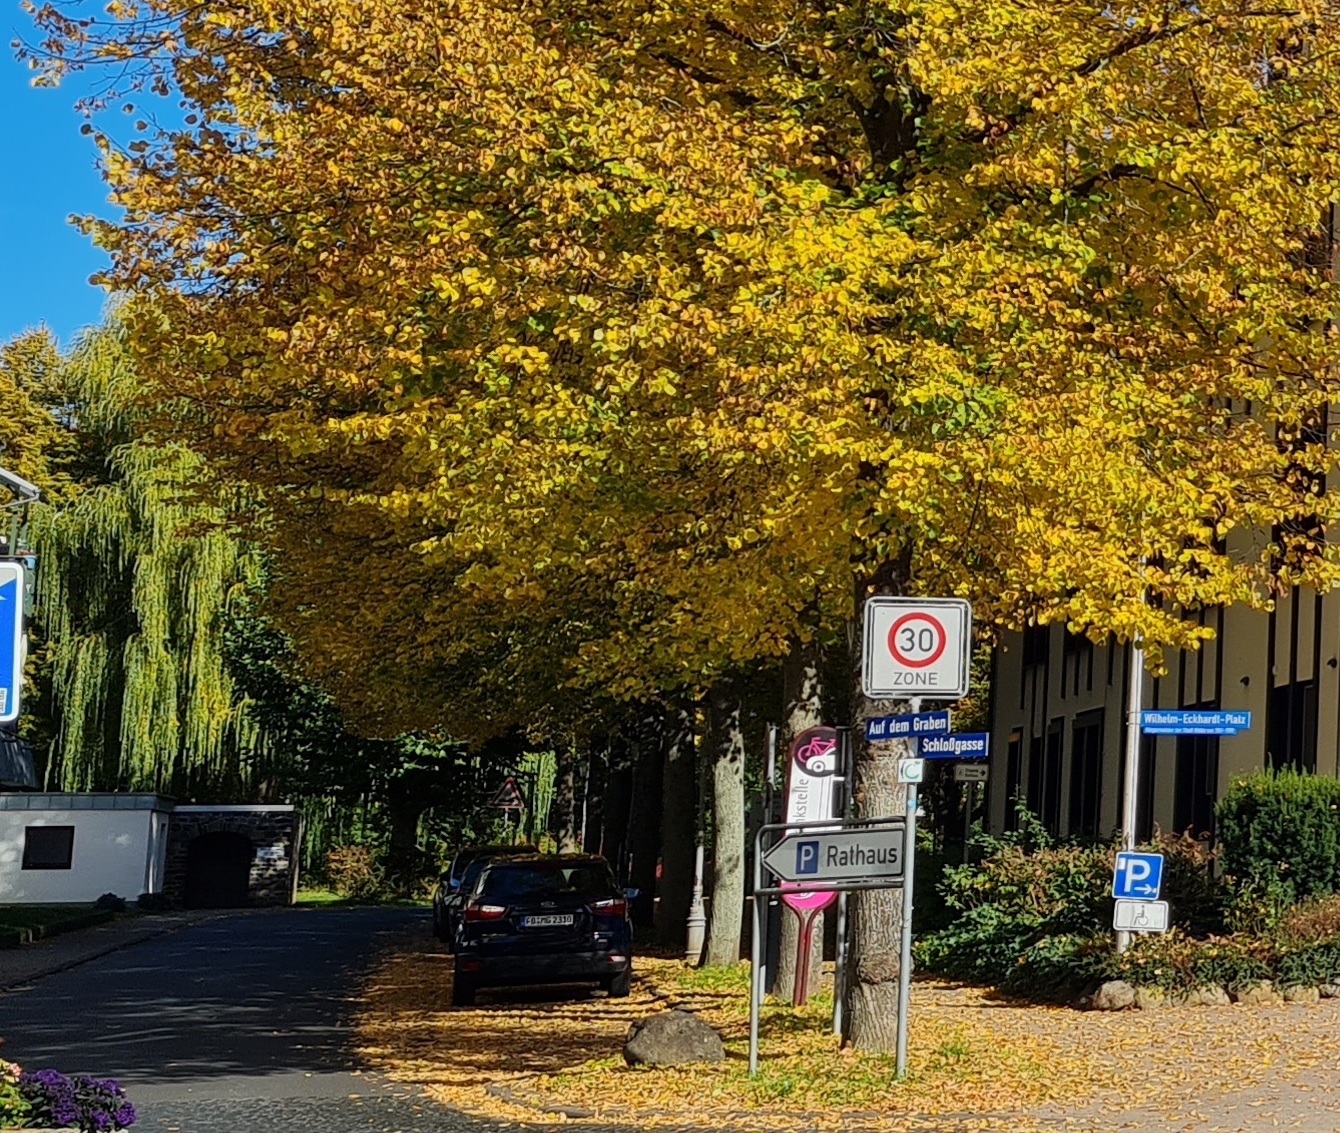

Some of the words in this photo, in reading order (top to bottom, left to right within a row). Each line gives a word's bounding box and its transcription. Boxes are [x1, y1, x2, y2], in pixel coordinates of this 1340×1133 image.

[899, 627, 934, 653] 30
[893, 671, 939, 686] ZONE
[868, 719, 885, 736] Auf
[889, 718, 910, 733] dem
[913, 715, 946, 732] Graben
[922, 737, 984, 755] Schloßgasse
[800, 845, 814, 871] P
[826, 843, 898, 868] Rathaus
[1123, 858, 1151, 893] P
